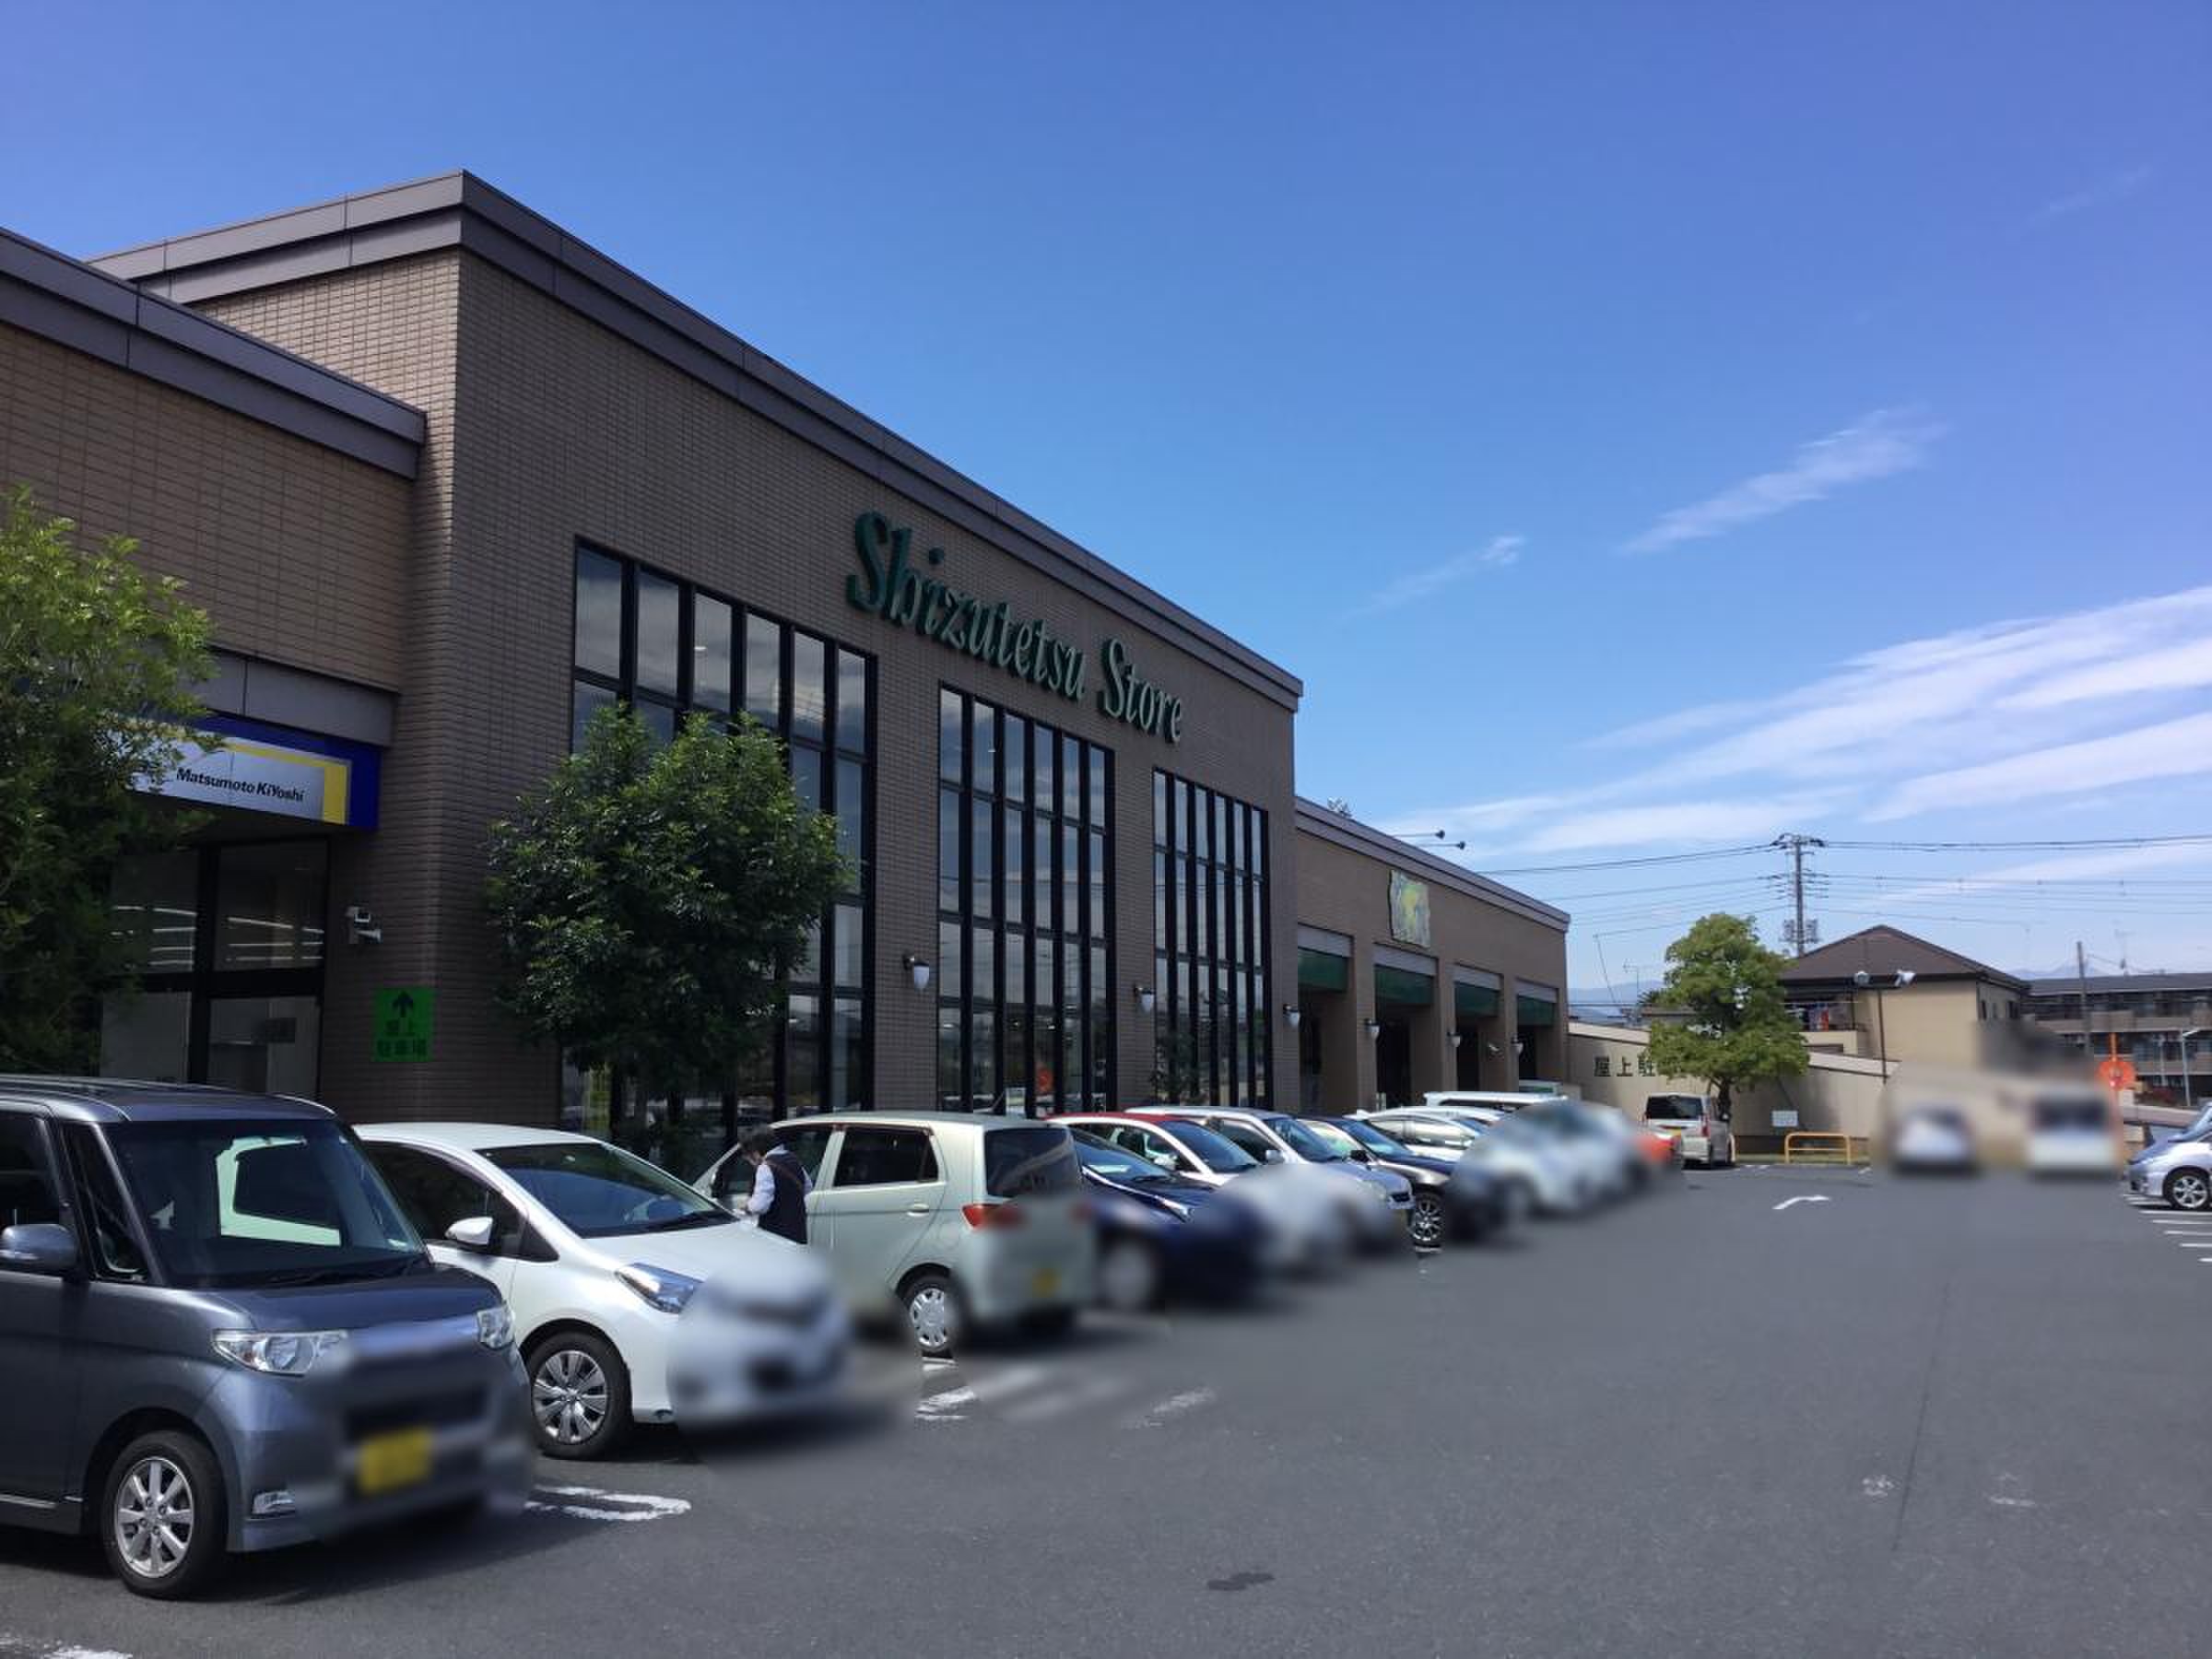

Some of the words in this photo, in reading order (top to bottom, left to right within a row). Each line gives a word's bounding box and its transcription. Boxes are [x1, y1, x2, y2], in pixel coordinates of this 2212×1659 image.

[845, 509, 1087, 702] Shizutetsu
[1097, 638, 1182, 744] Store
[177, 768, 255, 794] Matsumoto
